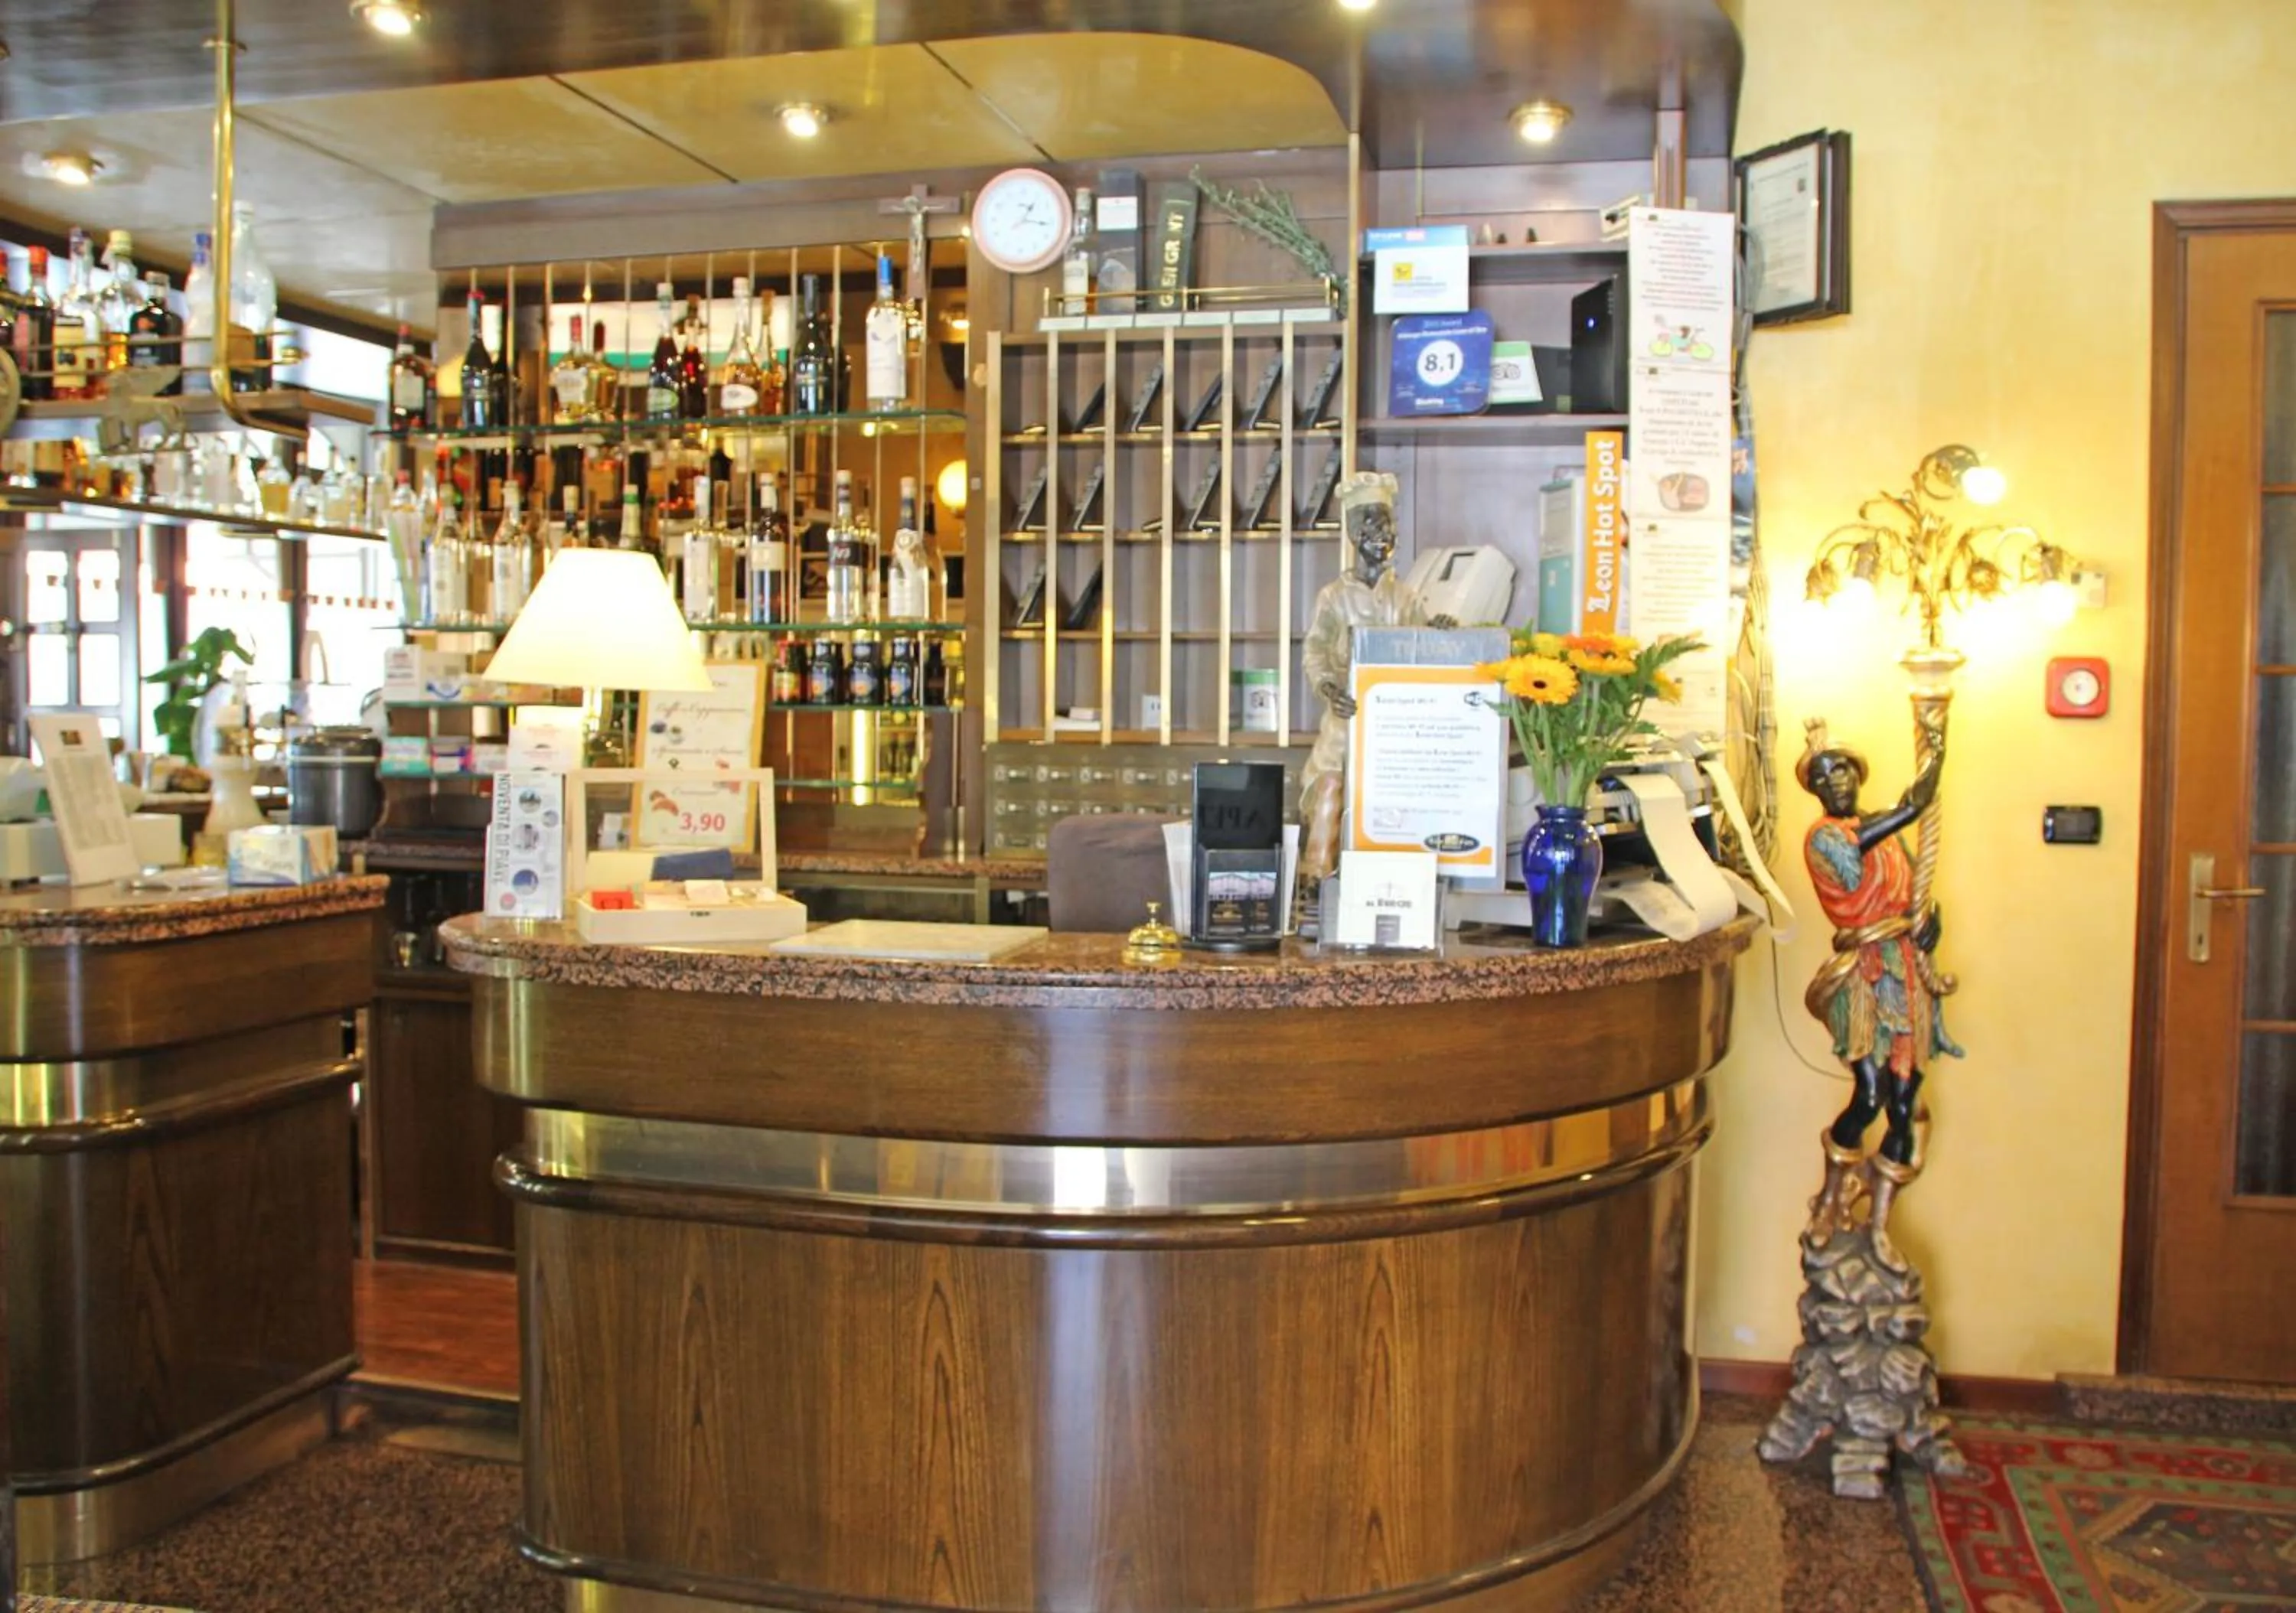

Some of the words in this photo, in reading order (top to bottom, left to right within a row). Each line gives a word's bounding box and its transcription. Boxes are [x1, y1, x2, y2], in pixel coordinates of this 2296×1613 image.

[1163, 210, 1186, 265] GRNT
[1159, 267, 1179, 307] GEN
[1424, 352, 1455, 373] 8,1
[1593, 439, 1619, 497] Spot
[1593, 503, 1615, 547] Hot
[497, 773, 511, 830] NOVENTA
[680, 810, 726, 833] 3,90
[496, 833, 510, 846] DI
